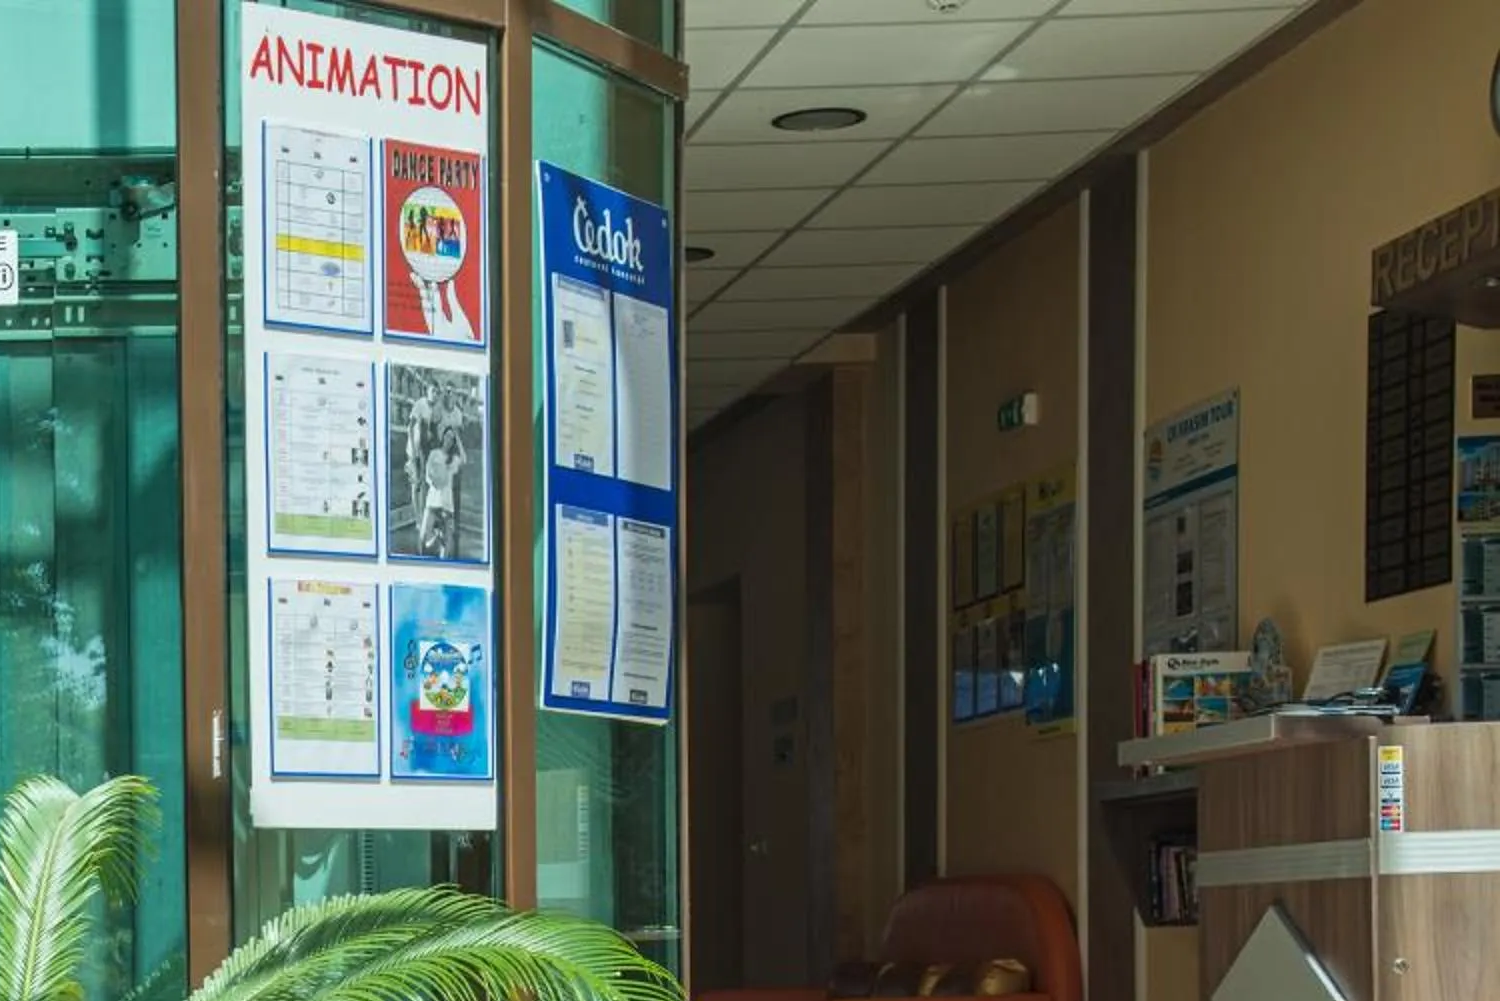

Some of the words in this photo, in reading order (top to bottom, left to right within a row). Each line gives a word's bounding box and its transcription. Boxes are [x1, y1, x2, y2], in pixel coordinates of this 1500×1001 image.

[250, 35, 481, 115] ANIMATION
[392, 149, 435, 183] DANCE
[437, 156, 480, 191] PARTY
[573, 195, 644, 272] Čedok
